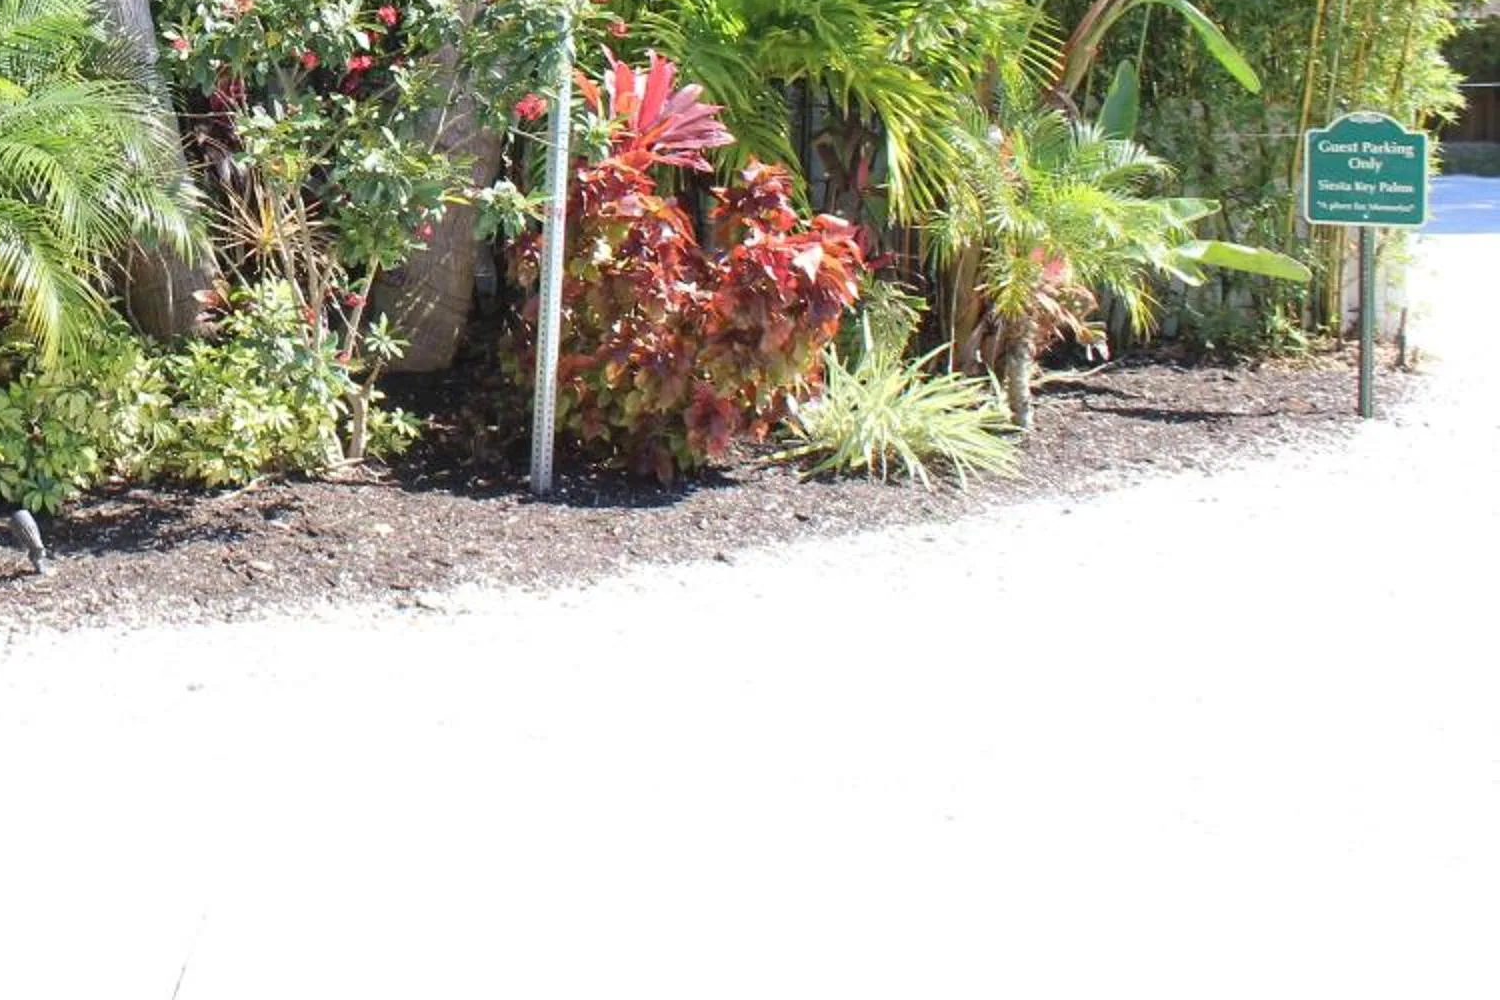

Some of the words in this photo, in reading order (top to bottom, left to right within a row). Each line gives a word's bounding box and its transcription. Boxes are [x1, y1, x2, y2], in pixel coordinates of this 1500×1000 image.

[1318, 140, 1358, 153] Guest
[1362, 141, 1415, 158] Parking
[1348, 157, 1383, 174] Only
